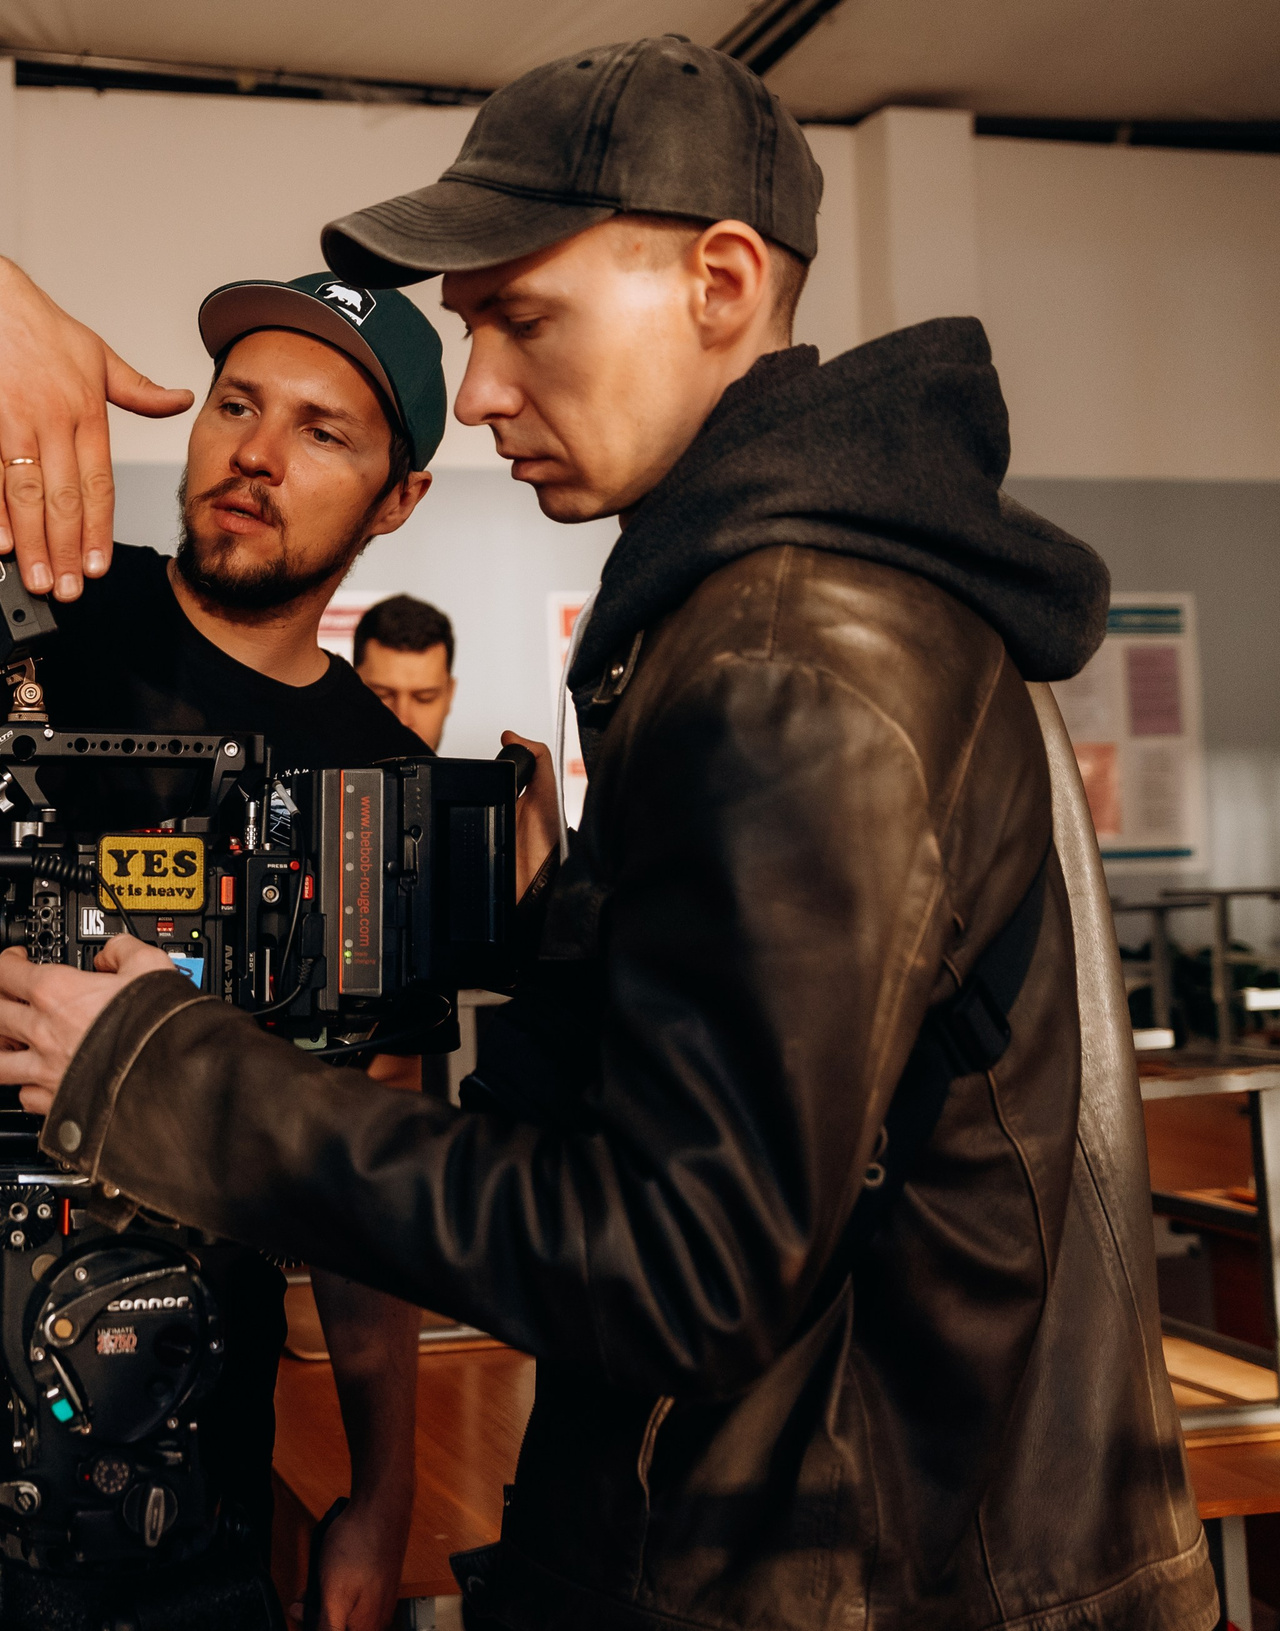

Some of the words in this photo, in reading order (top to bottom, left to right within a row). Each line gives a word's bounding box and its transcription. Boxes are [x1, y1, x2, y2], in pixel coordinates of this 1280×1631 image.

[107, 849, 198, 878] YES
[357, 796, 372, 947] www.bebob-rouge.com
[128, 884, 143, 896] is
[146, 884, 196, 899] heavy
[83, 909, 105, 935] LKS
